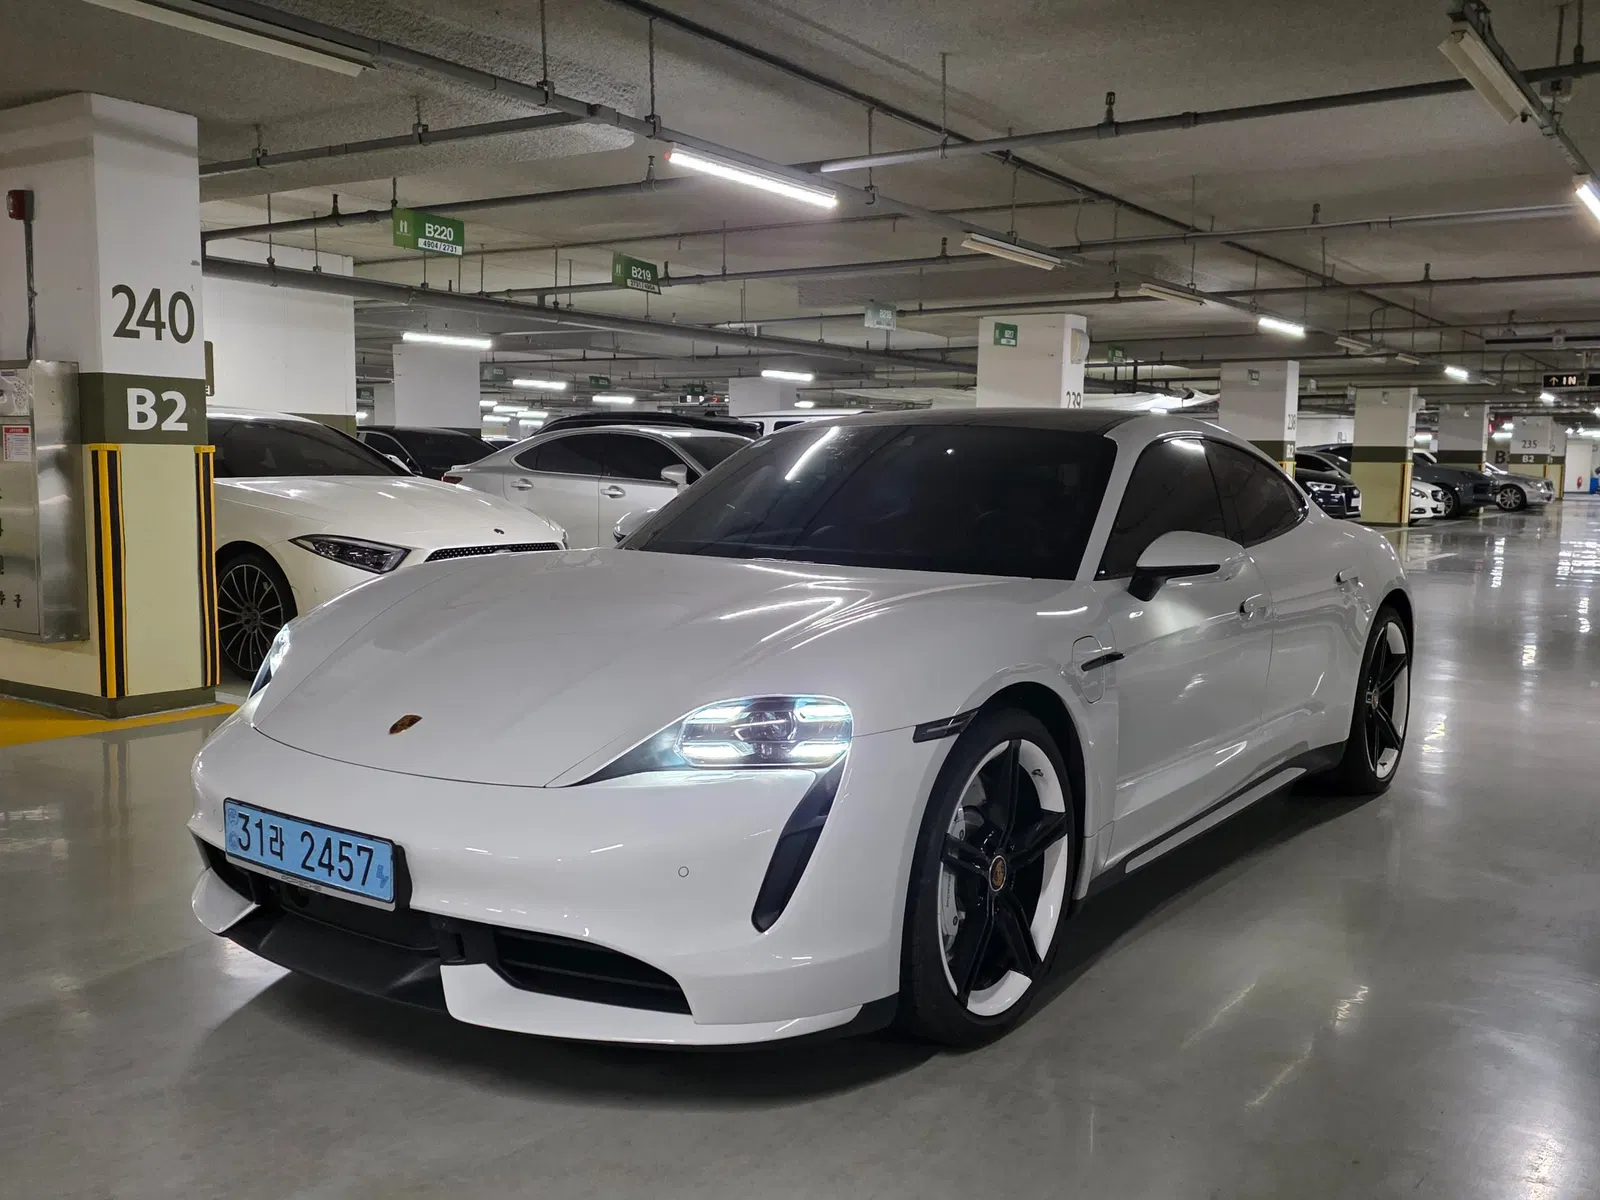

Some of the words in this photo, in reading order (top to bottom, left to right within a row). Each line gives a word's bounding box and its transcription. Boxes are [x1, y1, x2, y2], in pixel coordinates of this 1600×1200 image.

[425, 222, 454, 241] B220
[631, 265, 652, 281] B219
[112, 284, 195, 344] 240
[1562, 376, 1577, 385] IN
[126, 387, 188, 431] B2
[1521, 439, 1538, 449] 235
[1522, 455, 1535, 463] B2
[238, 812, 285, 862] 31라
[301, 831, 374, 887] 2457
